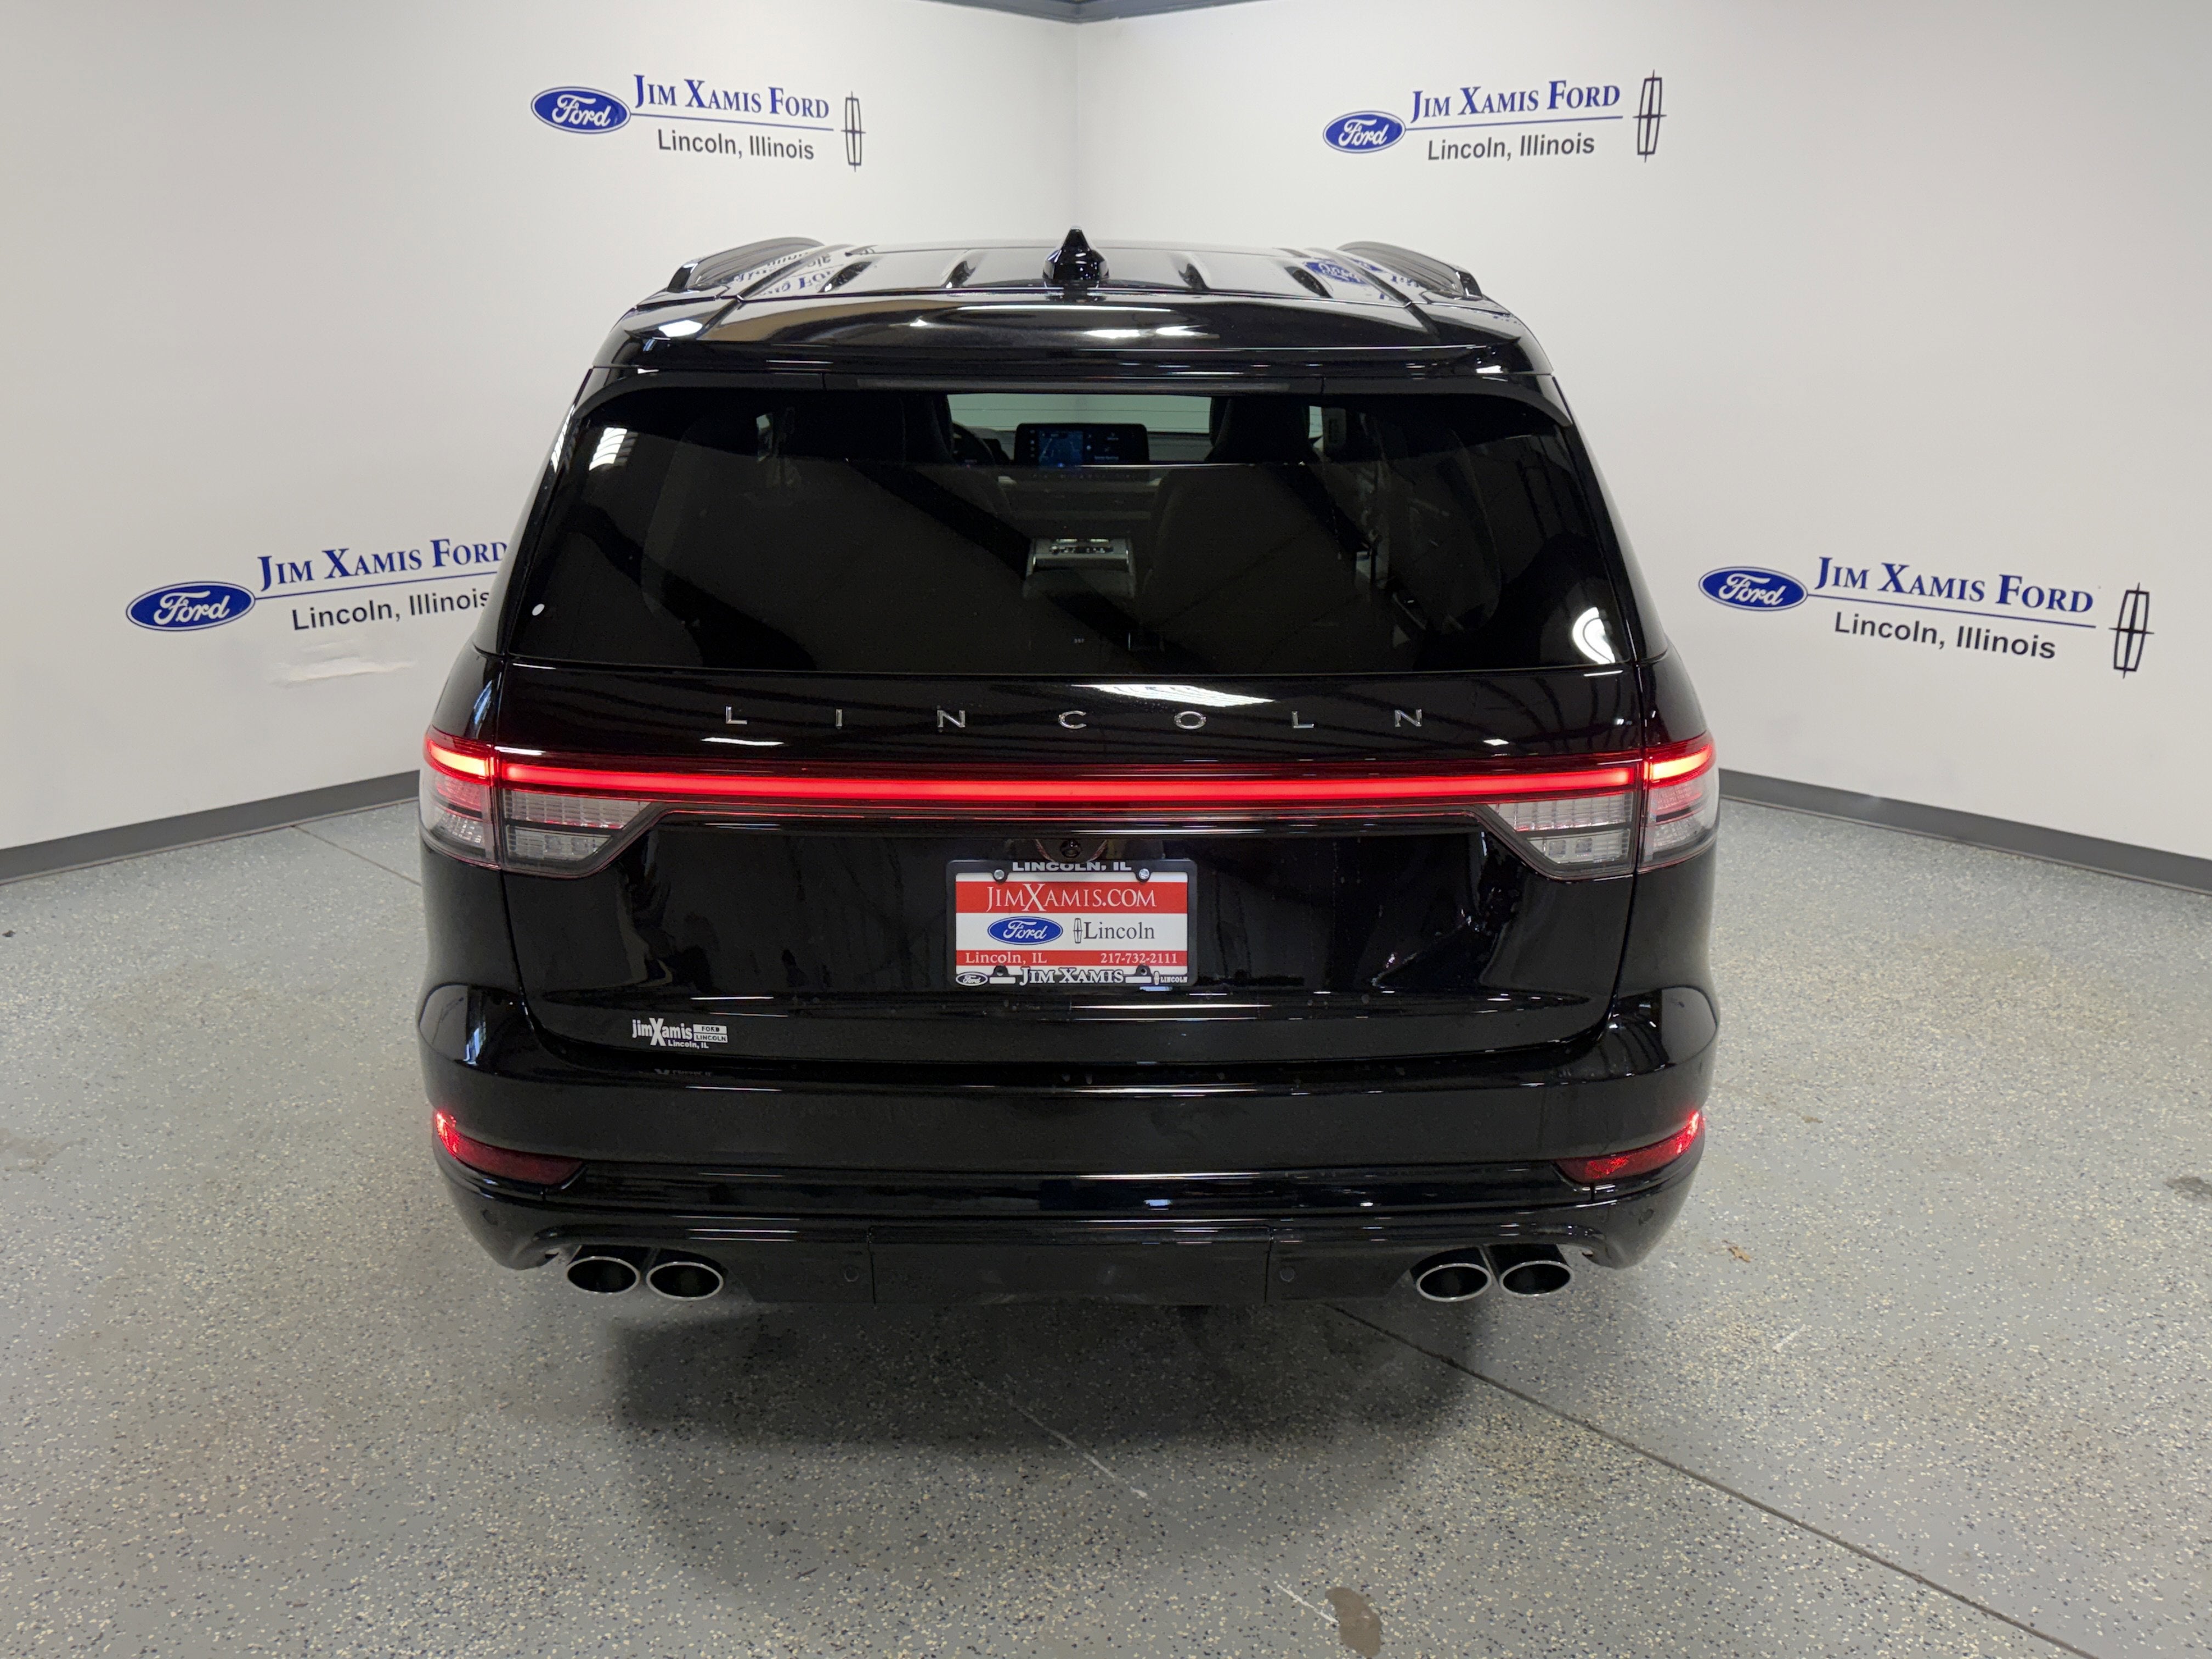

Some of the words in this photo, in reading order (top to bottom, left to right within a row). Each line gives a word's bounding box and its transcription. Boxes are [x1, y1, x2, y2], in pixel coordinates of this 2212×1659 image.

[551, 94, 611, 127] Ford
[634, 74, 676, 108] JIM
[684, 79, 762, 113] XAMIS
[768, 86, 830, 119] FORD
[1410, 91, 1452, 123] JIM
[1458, 86, 1538, 116] XAMIS
[1547, 80, 1620, 111] FORD
[658, 129, 742, 159] Lincoln,
[749, 136, 815, 160] Illinois
[1338, 119, 1387, 146] Ford
[1427, 137, 1513, 161] Lincoln,
[1520, 132, 1595, 157] Illinois
[257, 555, 313, 591] JIM
[321, 548, 422, 579] XAMIS
[430, 539, 507, 565] FORD
[1718, 572, 1784, 606] Ford
[1814, 556, 1868, 590] JIM
[1878, 562, 1985, 602] XAMIS
[1995, 573, 2094, 613] FORD
[153, 590, 230, 625] Ford
[291, 600, 400, 631] Lincoln,
[1835, 612, 1945, 651] Lincoln,
[1956, 625, 2056, 659] Illinois
[725, 706, 1423, 731] LINCOLN
[1012, 862, 1107, 871] LINCOLN,
[1113, 861, 1132, 871] IL
[986, 883, 1157, 912] JIMXAMIS.COM
[1003, 920, 1047, 940] Ford
[1084, 921, 1155, 939] Lincoln
[966, 952, 1026, 964] Lincoln,
[1032, 952, 1047, 963] IL
[1101, 953, 1177, 963] 217-732-2111
[1019, 967, 1055, 986] JIM
[1058, 967, 1124, 984] XAMIS
[668, 1039, 699, 1049] Lincoln,
